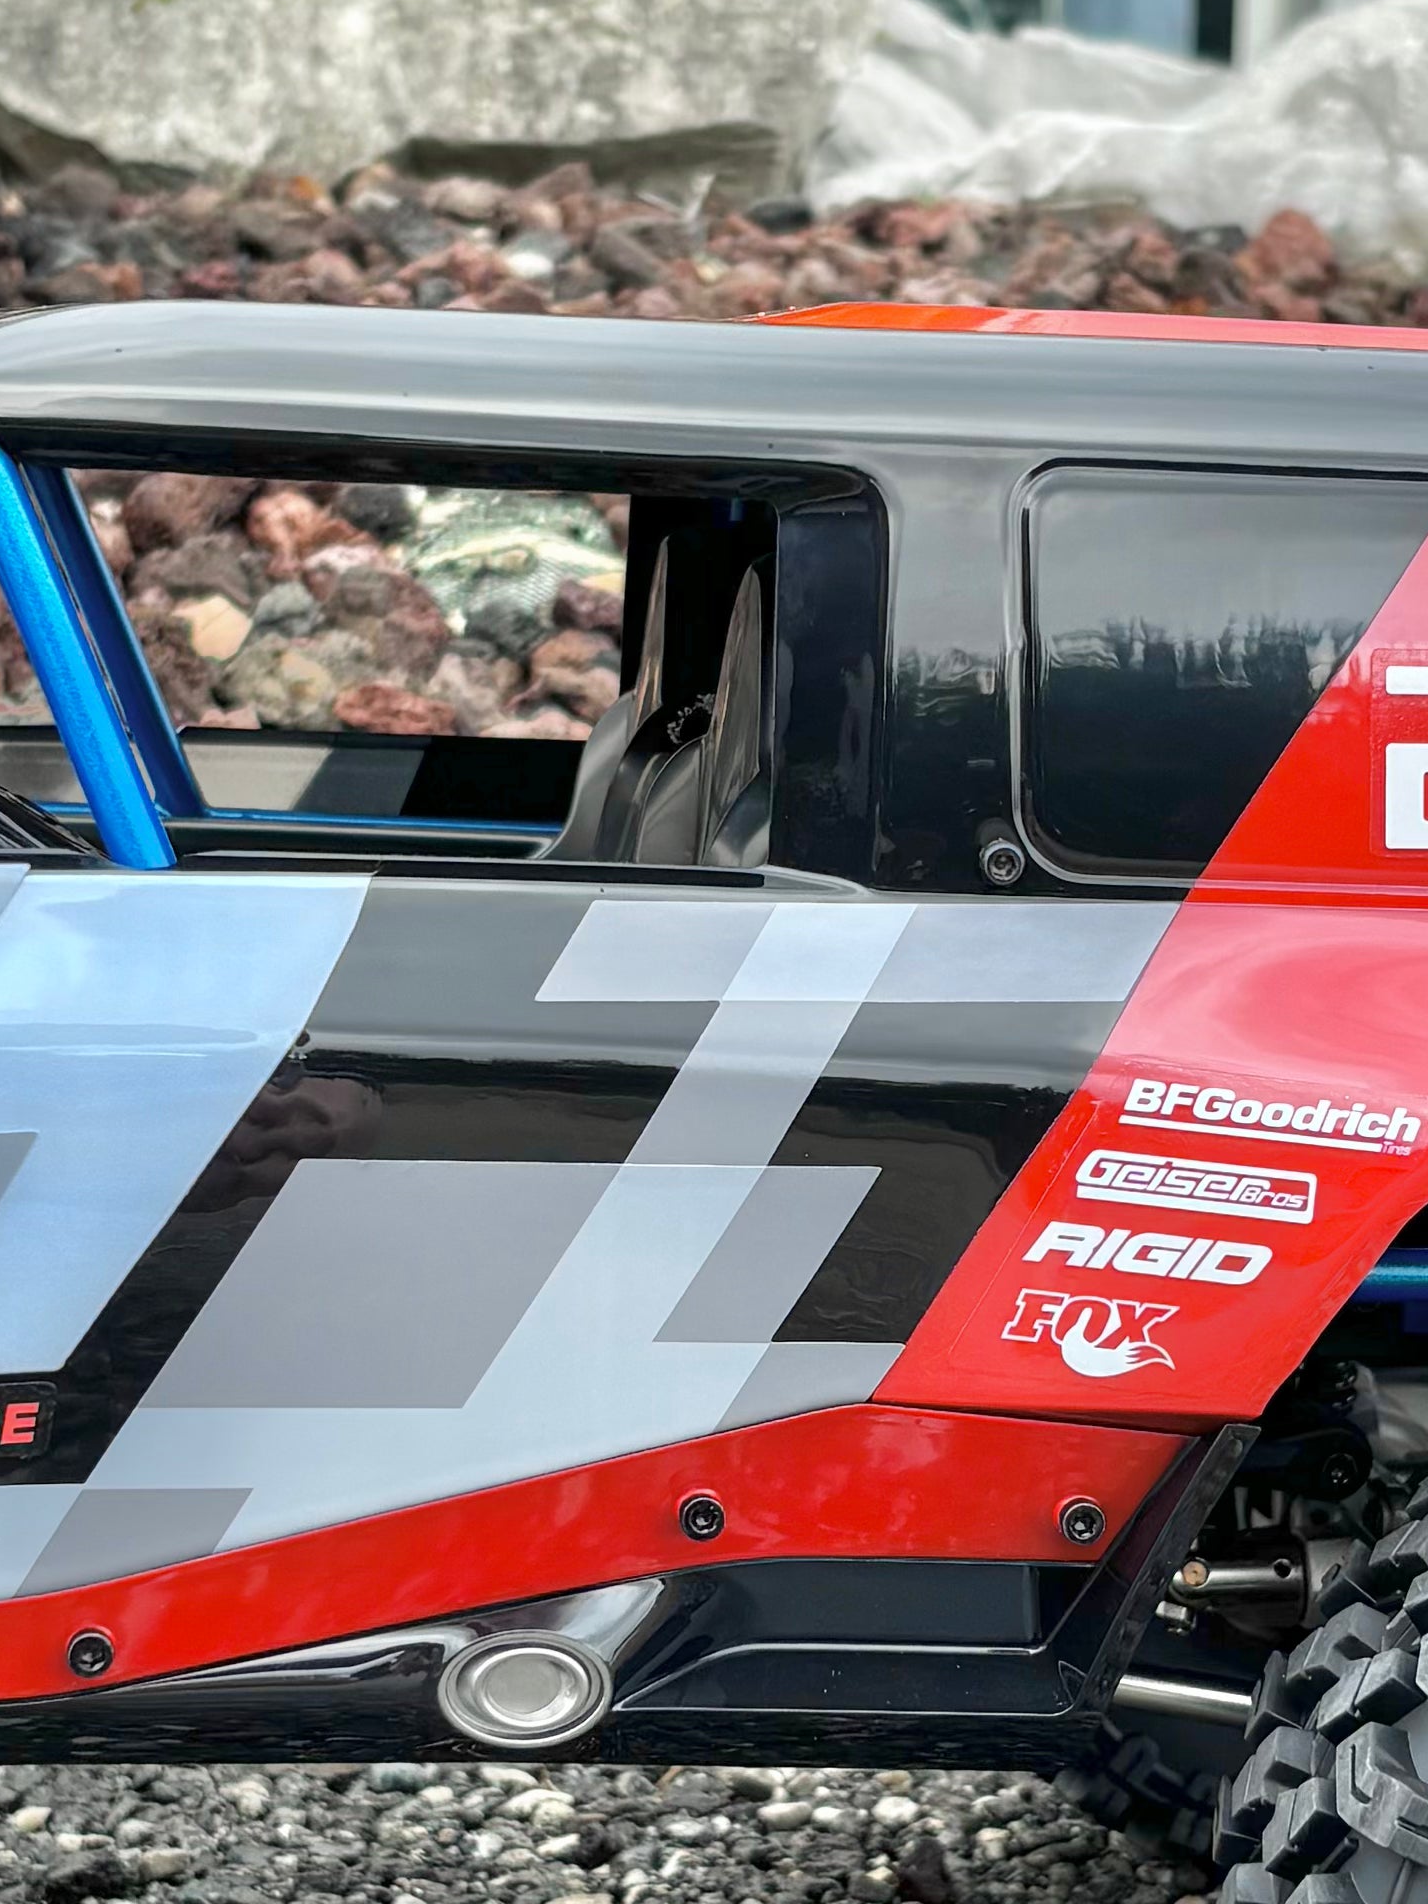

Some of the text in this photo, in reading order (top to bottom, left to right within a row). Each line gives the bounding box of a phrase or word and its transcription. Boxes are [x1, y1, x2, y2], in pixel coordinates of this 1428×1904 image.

[1124, 1078, 1422, 1143] BFGoodrich
[1022, 1221, 1274, 1285] RIGID
[1001, 1288, 1180, 1377] FOX
